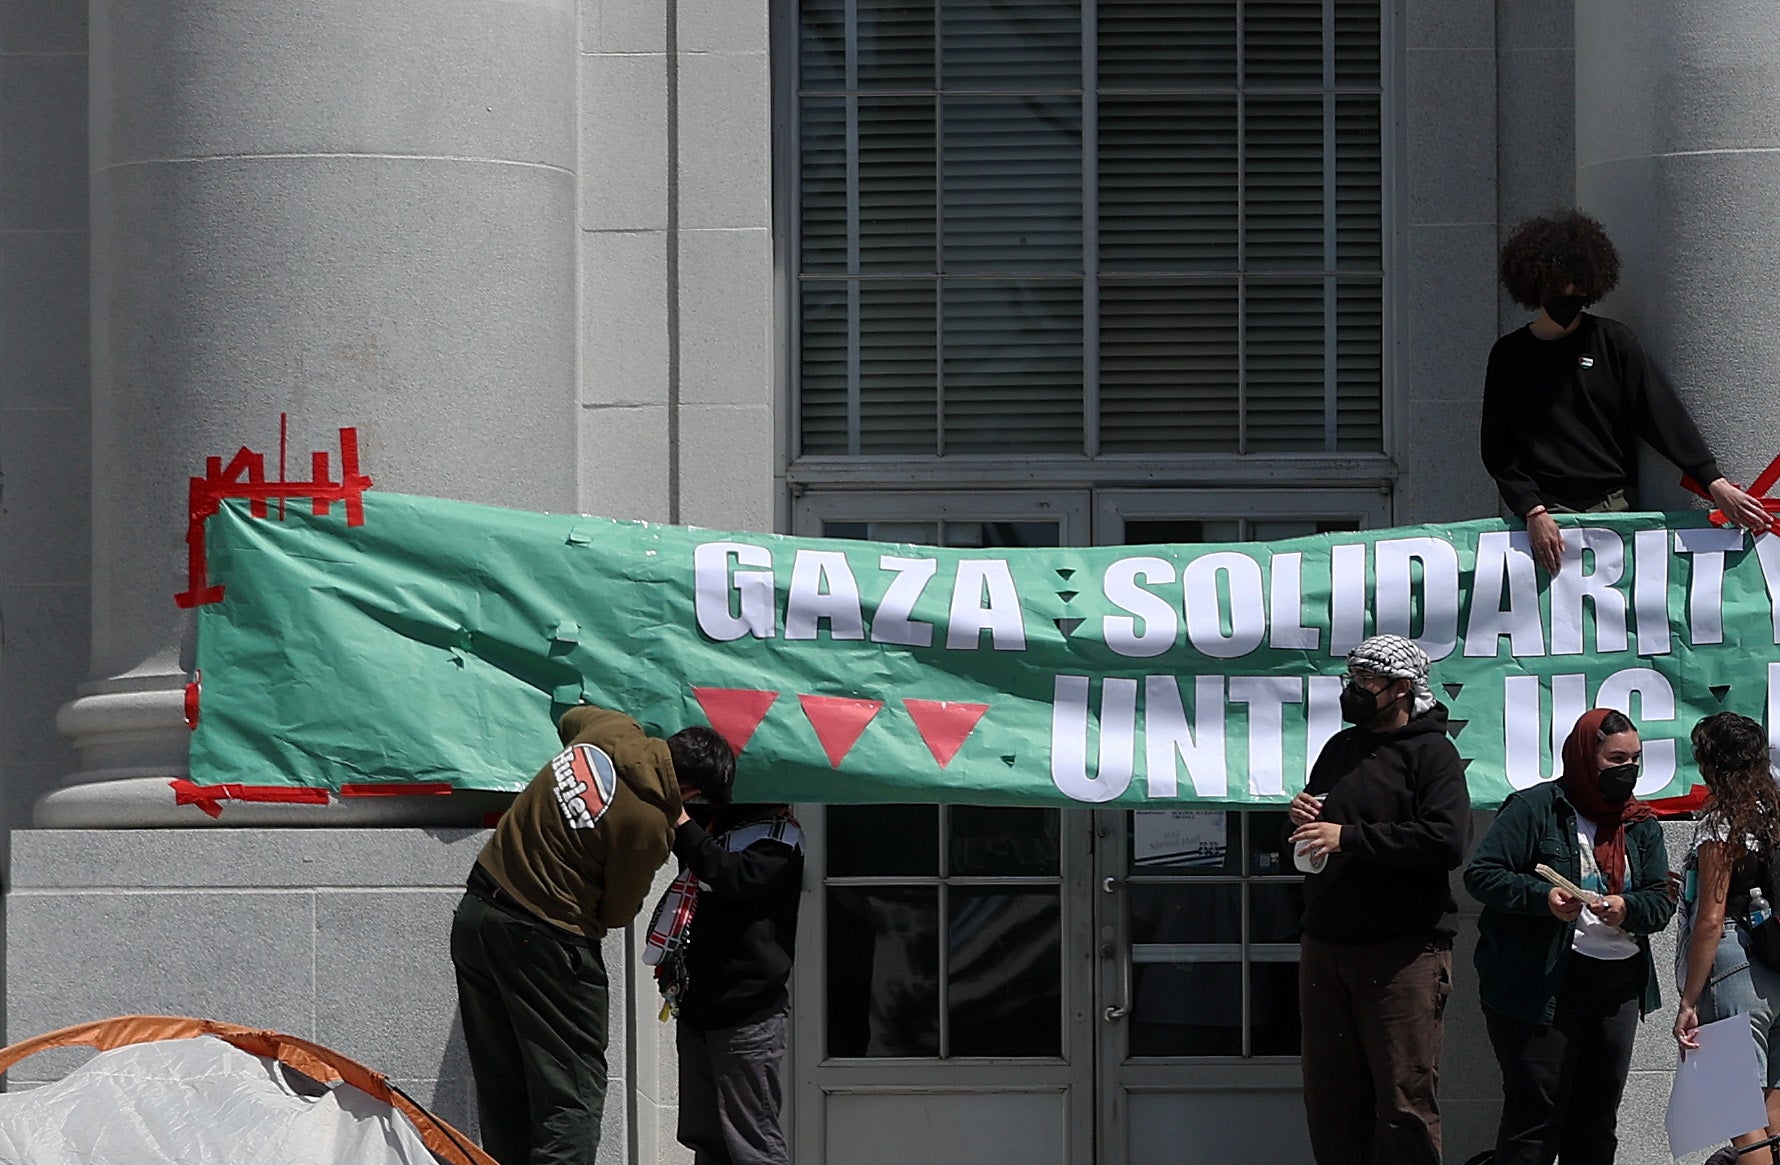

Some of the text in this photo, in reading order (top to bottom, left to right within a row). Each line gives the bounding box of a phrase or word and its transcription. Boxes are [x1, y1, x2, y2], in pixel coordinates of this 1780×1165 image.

[692, 541, 1028, 652] GAZA
[552, 746, 595, 829] Hurley
[1050, 674, 1342, 803] UNTI
[1504, 667, 1677, 798] UC
